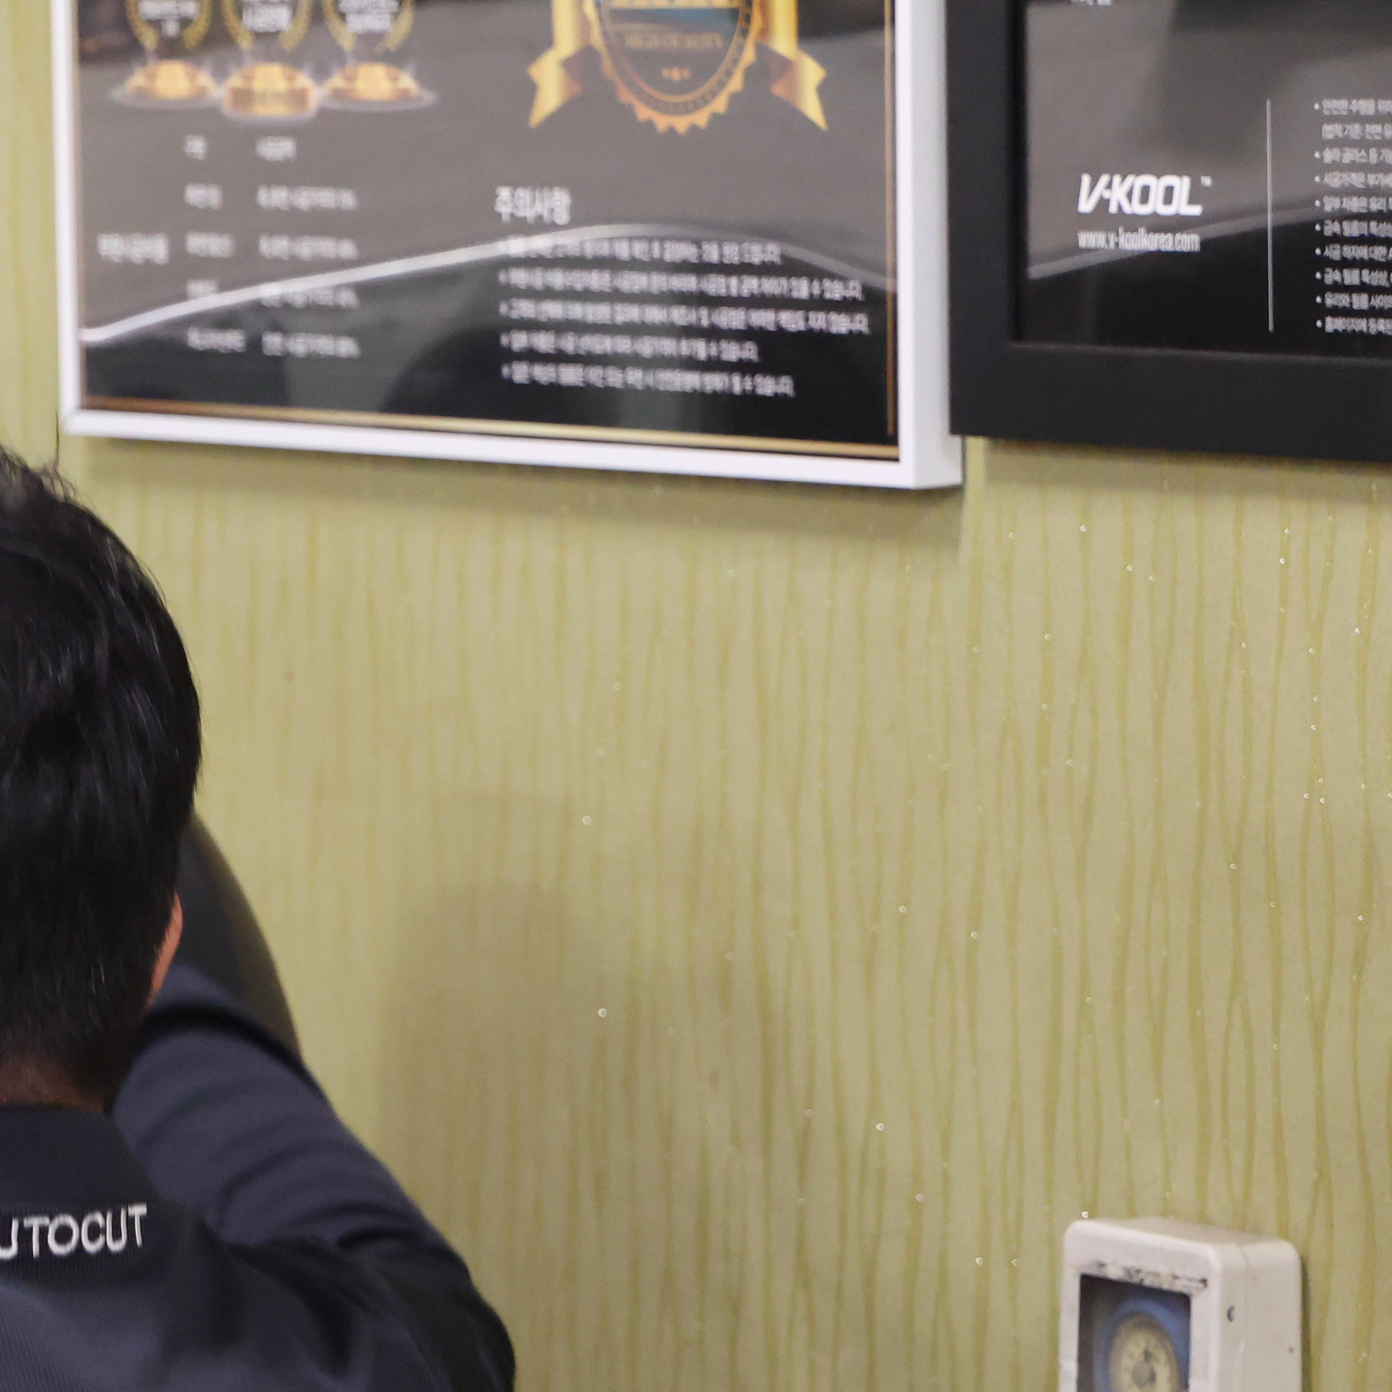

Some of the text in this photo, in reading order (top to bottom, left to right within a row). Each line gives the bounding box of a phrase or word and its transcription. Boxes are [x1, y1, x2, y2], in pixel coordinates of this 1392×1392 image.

[495, 186, 571, 225] 주의사항
[1078, 173, 1203, 216] V-KOOL
[1077, 226, 1201, 252] www.v-koolkorea.com
